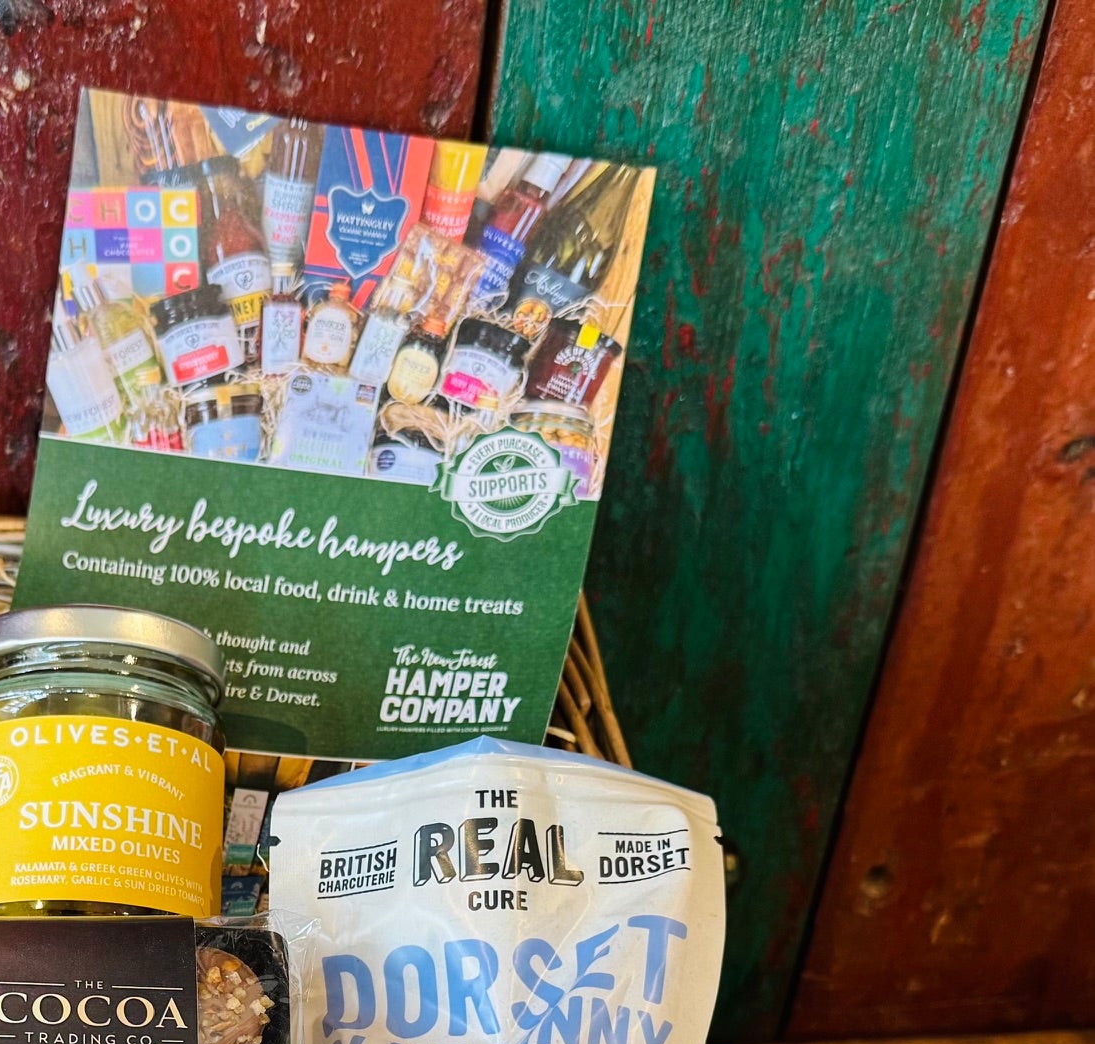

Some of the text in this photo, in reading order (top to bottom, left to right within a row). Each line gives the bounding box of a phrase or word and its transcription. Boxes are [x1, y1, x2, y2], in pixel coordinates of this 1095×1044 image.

[469, 442, 495, 464] EVERY
[498, 439, 543, 460] PURCHASE
[468, 473, 547, 497] SUPPORTS
[61, 479, 464, 576] Luxury bespoke hampers
[479, 512, 503, 529] LOCAL
[506, 500, 547, 528] PRODUCER
[62, 550, 524, 615] Containing 100% local food, drink & home treats
[216, 630, 277, 653] thought
[279, 640, 311, 655] and
[393, 644, 420, 666] The
[243, 659, 284, 678] from
[287, 666, 338, 683] across
[385, 667, 508, 698] HAMPER
[250, 685, 262, 700] &
[266, 687, 321, 707] Dorset.
[379, 696, 521, 724] COMPANY
[52, 764, 185, 800] FRAGRANT & VIBRANT
[475, 789, 519, 808] THE
[19, 801, 202, 849] SUNSHINE
[52, 836, 181, 865] MIXED OLIVES
[413, 817, 585, 887] REAL
[614, 838, 671, 854] MADE IN
[320, 847, 397, 880] BRITISH
[599, 847, 690, 878] DORSET
[10, 874, 205, 907] ROSEMARY, GARLIC & SUN DRIED TOMATO
[14, 862, 203, 893] KALAMATA & GREEK GREEN OLIVES WITH
[317, 869, 396, 894] CHARCUTERIE
[468, 890, 528, 912] CURE
[74, 979, 104, 990] THE
[321, 914, 688, 1039] DORSET
